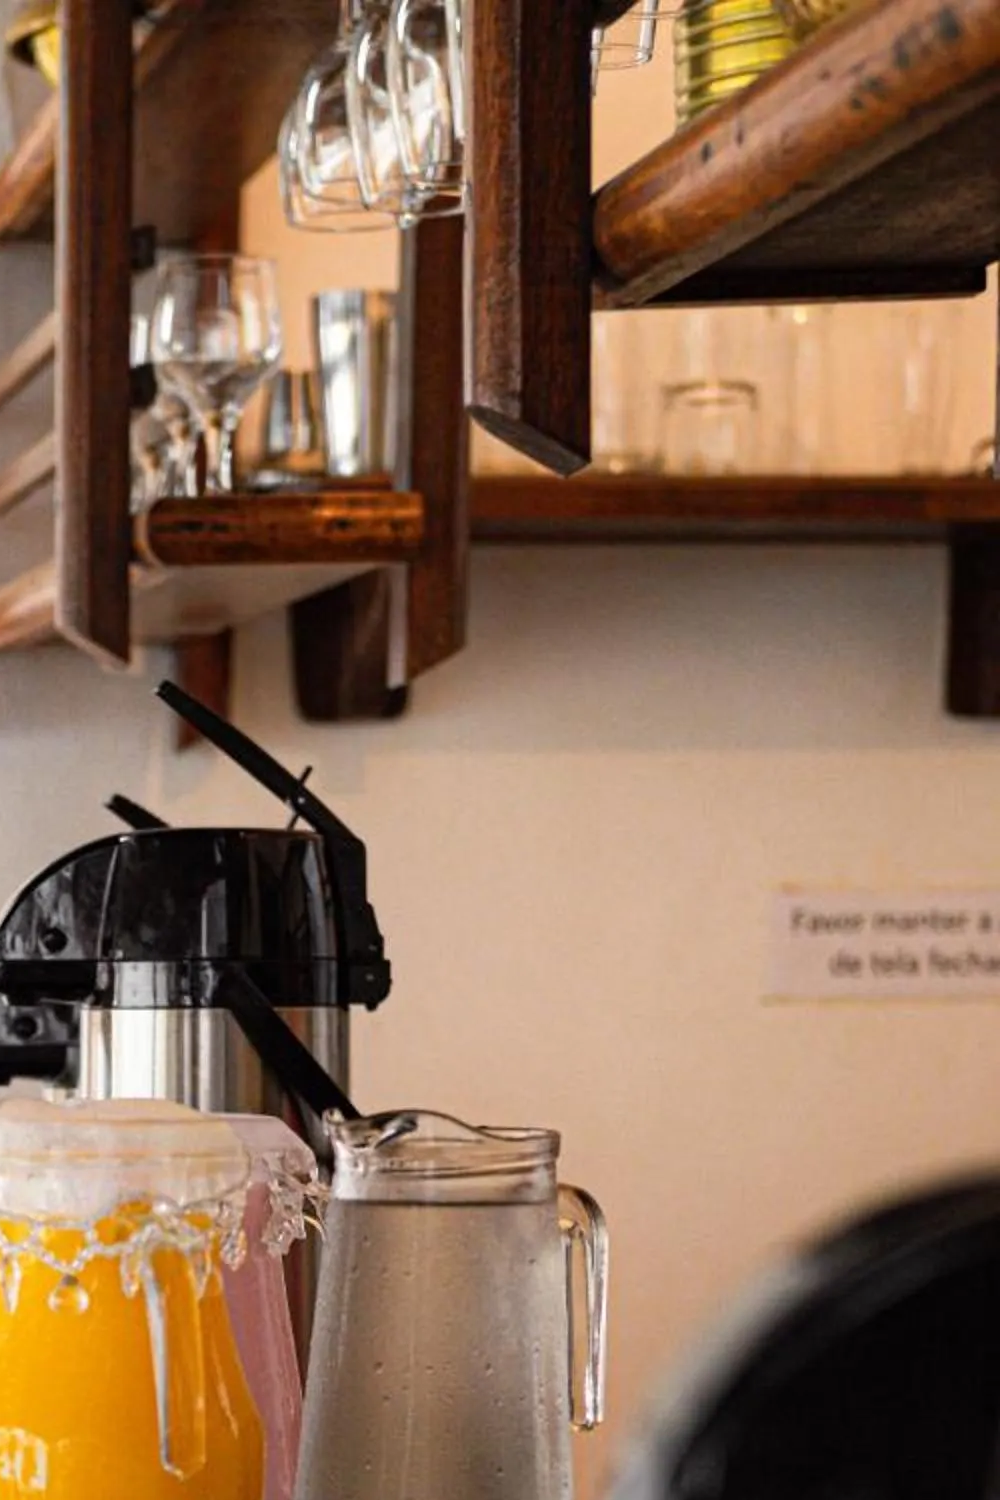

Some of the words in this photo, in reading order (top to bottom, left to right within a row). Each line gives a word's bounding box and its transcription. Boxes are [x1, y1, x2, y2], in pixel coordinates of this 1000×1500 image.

[790, 908, 865, 936] Favor
[871, 909, 968, 934] manter
[828, 949, 862, 978] de
[870, 949, 920, 978] tela
